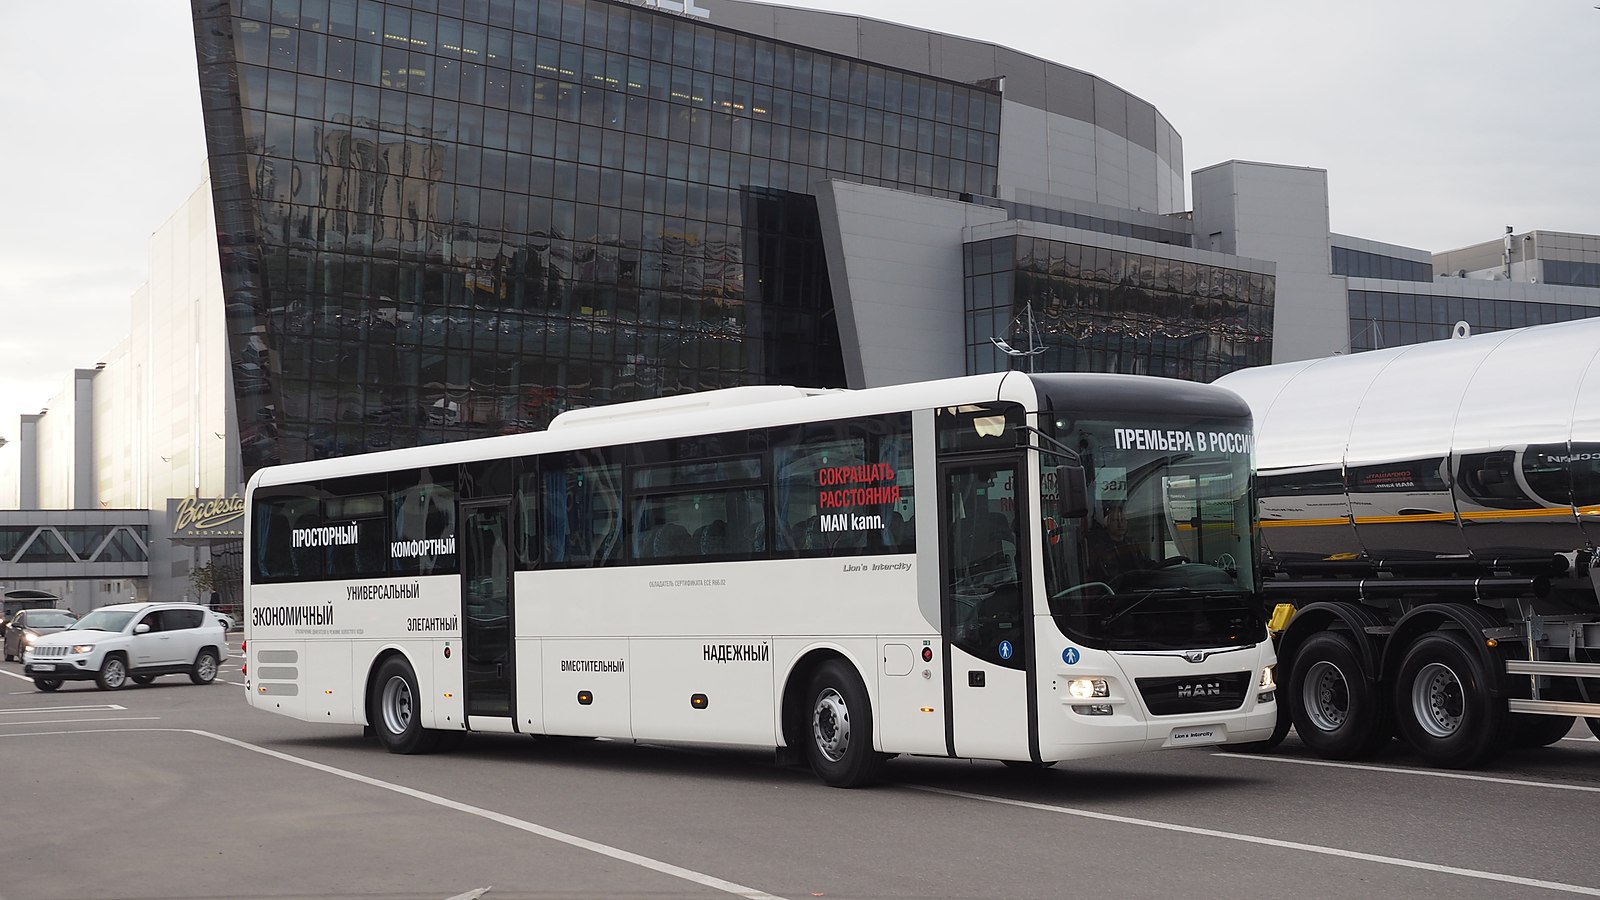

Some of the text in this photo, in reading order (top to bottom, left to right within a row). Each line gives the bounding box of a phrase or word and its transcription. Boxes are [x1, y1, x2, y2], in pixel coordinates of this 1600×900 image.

[1114, 428, 1194, 451] ПРЕМЬЕРА
[1196, 431, 1207, 452] В
[819, 463, 895, 487] СОКРАЩАТЬ
[819, 484, 901, 509] РАССТОЯНИЯ
[292, 520, 358, 548] ПРОСТОРНЫЙ
[820, 513, 885, 533] MAN kann.
[391, 534, 456, 558] КОМФОРТНЫЙ
[843, 561, 912, 573] Lion's Intercity
[346, 580, 420, 600] УНИВЕРСАЛЬНЫЙ
[252, 601, 334, 627] ЭКОНОМИЧНЫЙ
[407, 615, 458, 632] ЭЛЕГАНТНЫЙ
[703, 641, 769, 664] НАДЕЖНЫЙ
[561, 658, 625, 673] ВМЕСТИТЕЛЬНЫЙ
[1177, 682, 1221, 698] MAN
